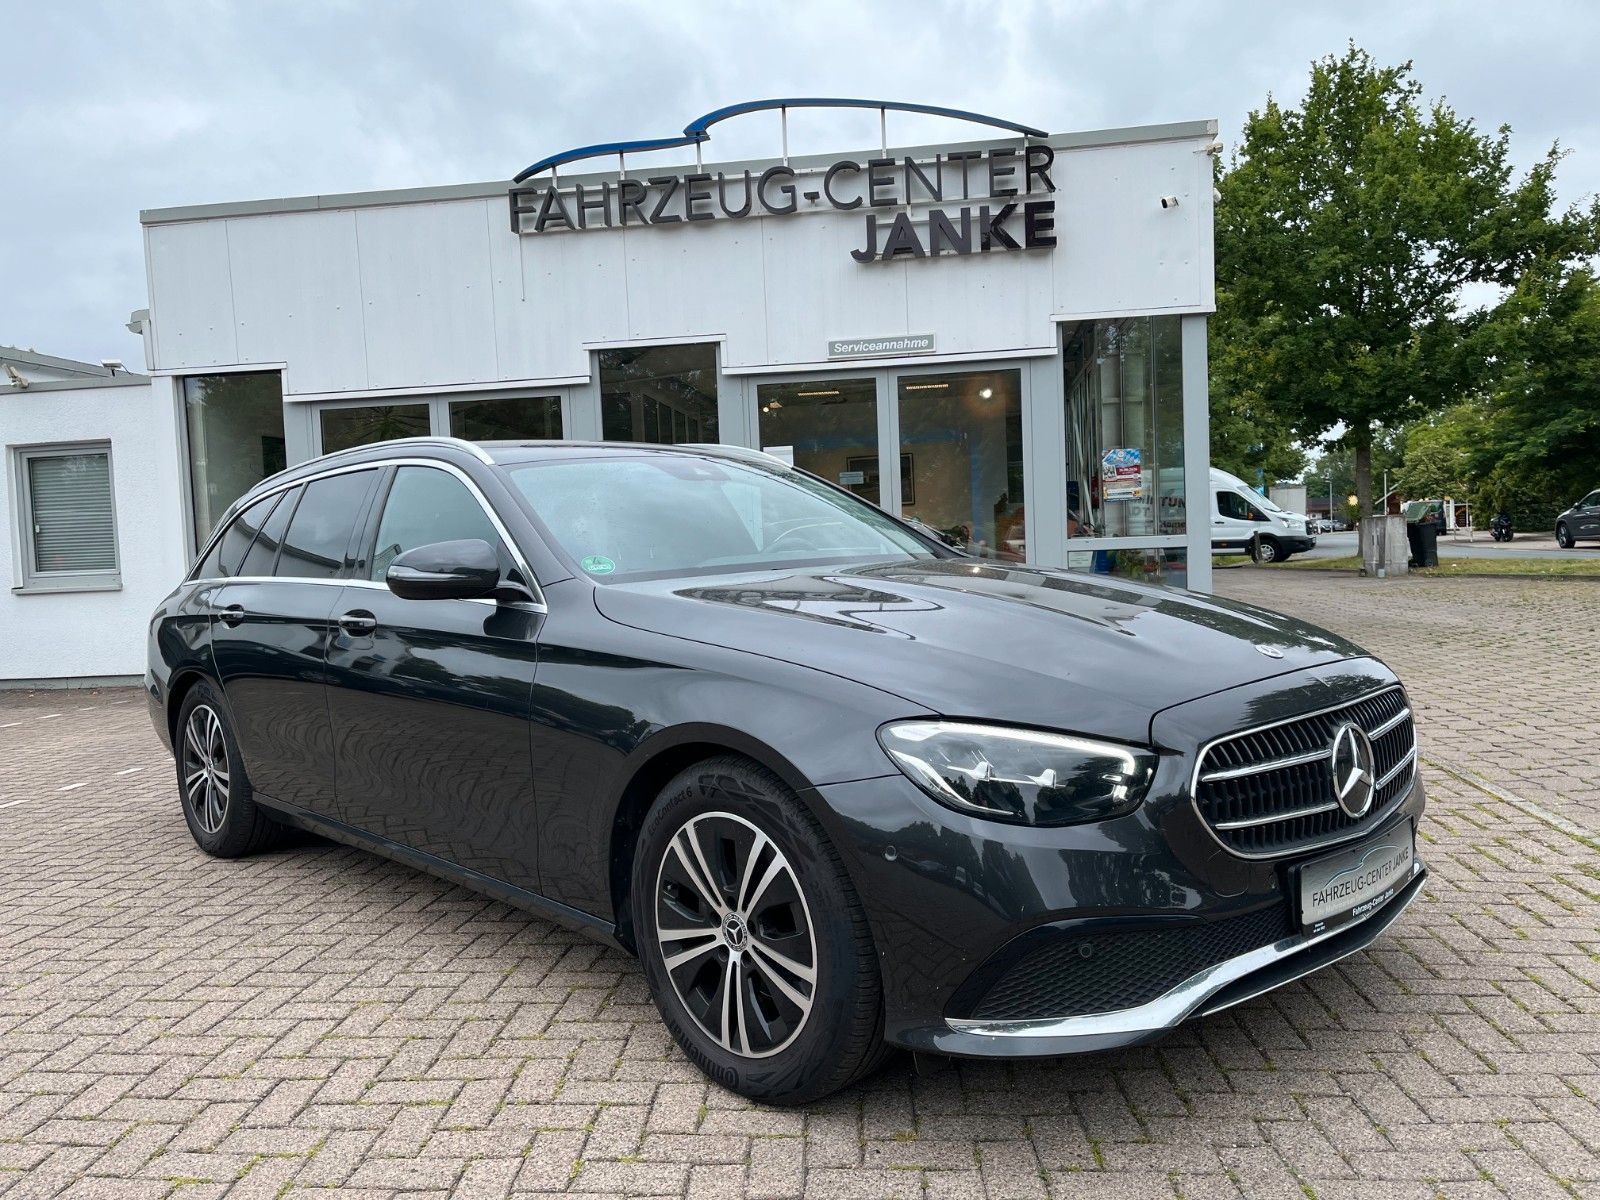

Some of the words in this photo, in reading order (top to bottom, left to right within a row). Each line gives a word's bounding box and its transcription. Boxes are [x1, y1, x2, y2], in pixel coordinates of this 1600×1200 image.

[508, 144, 1056, 234] FAHRZEUG-CENTER
[850, 201, 1057, 264] JANKE
[833, 338, 929, 354] Serviceannahme
[1312, 860, 1392, 907] FAHRZEUG-CENTER
[1393, 846, 1409, 870] JANKE
